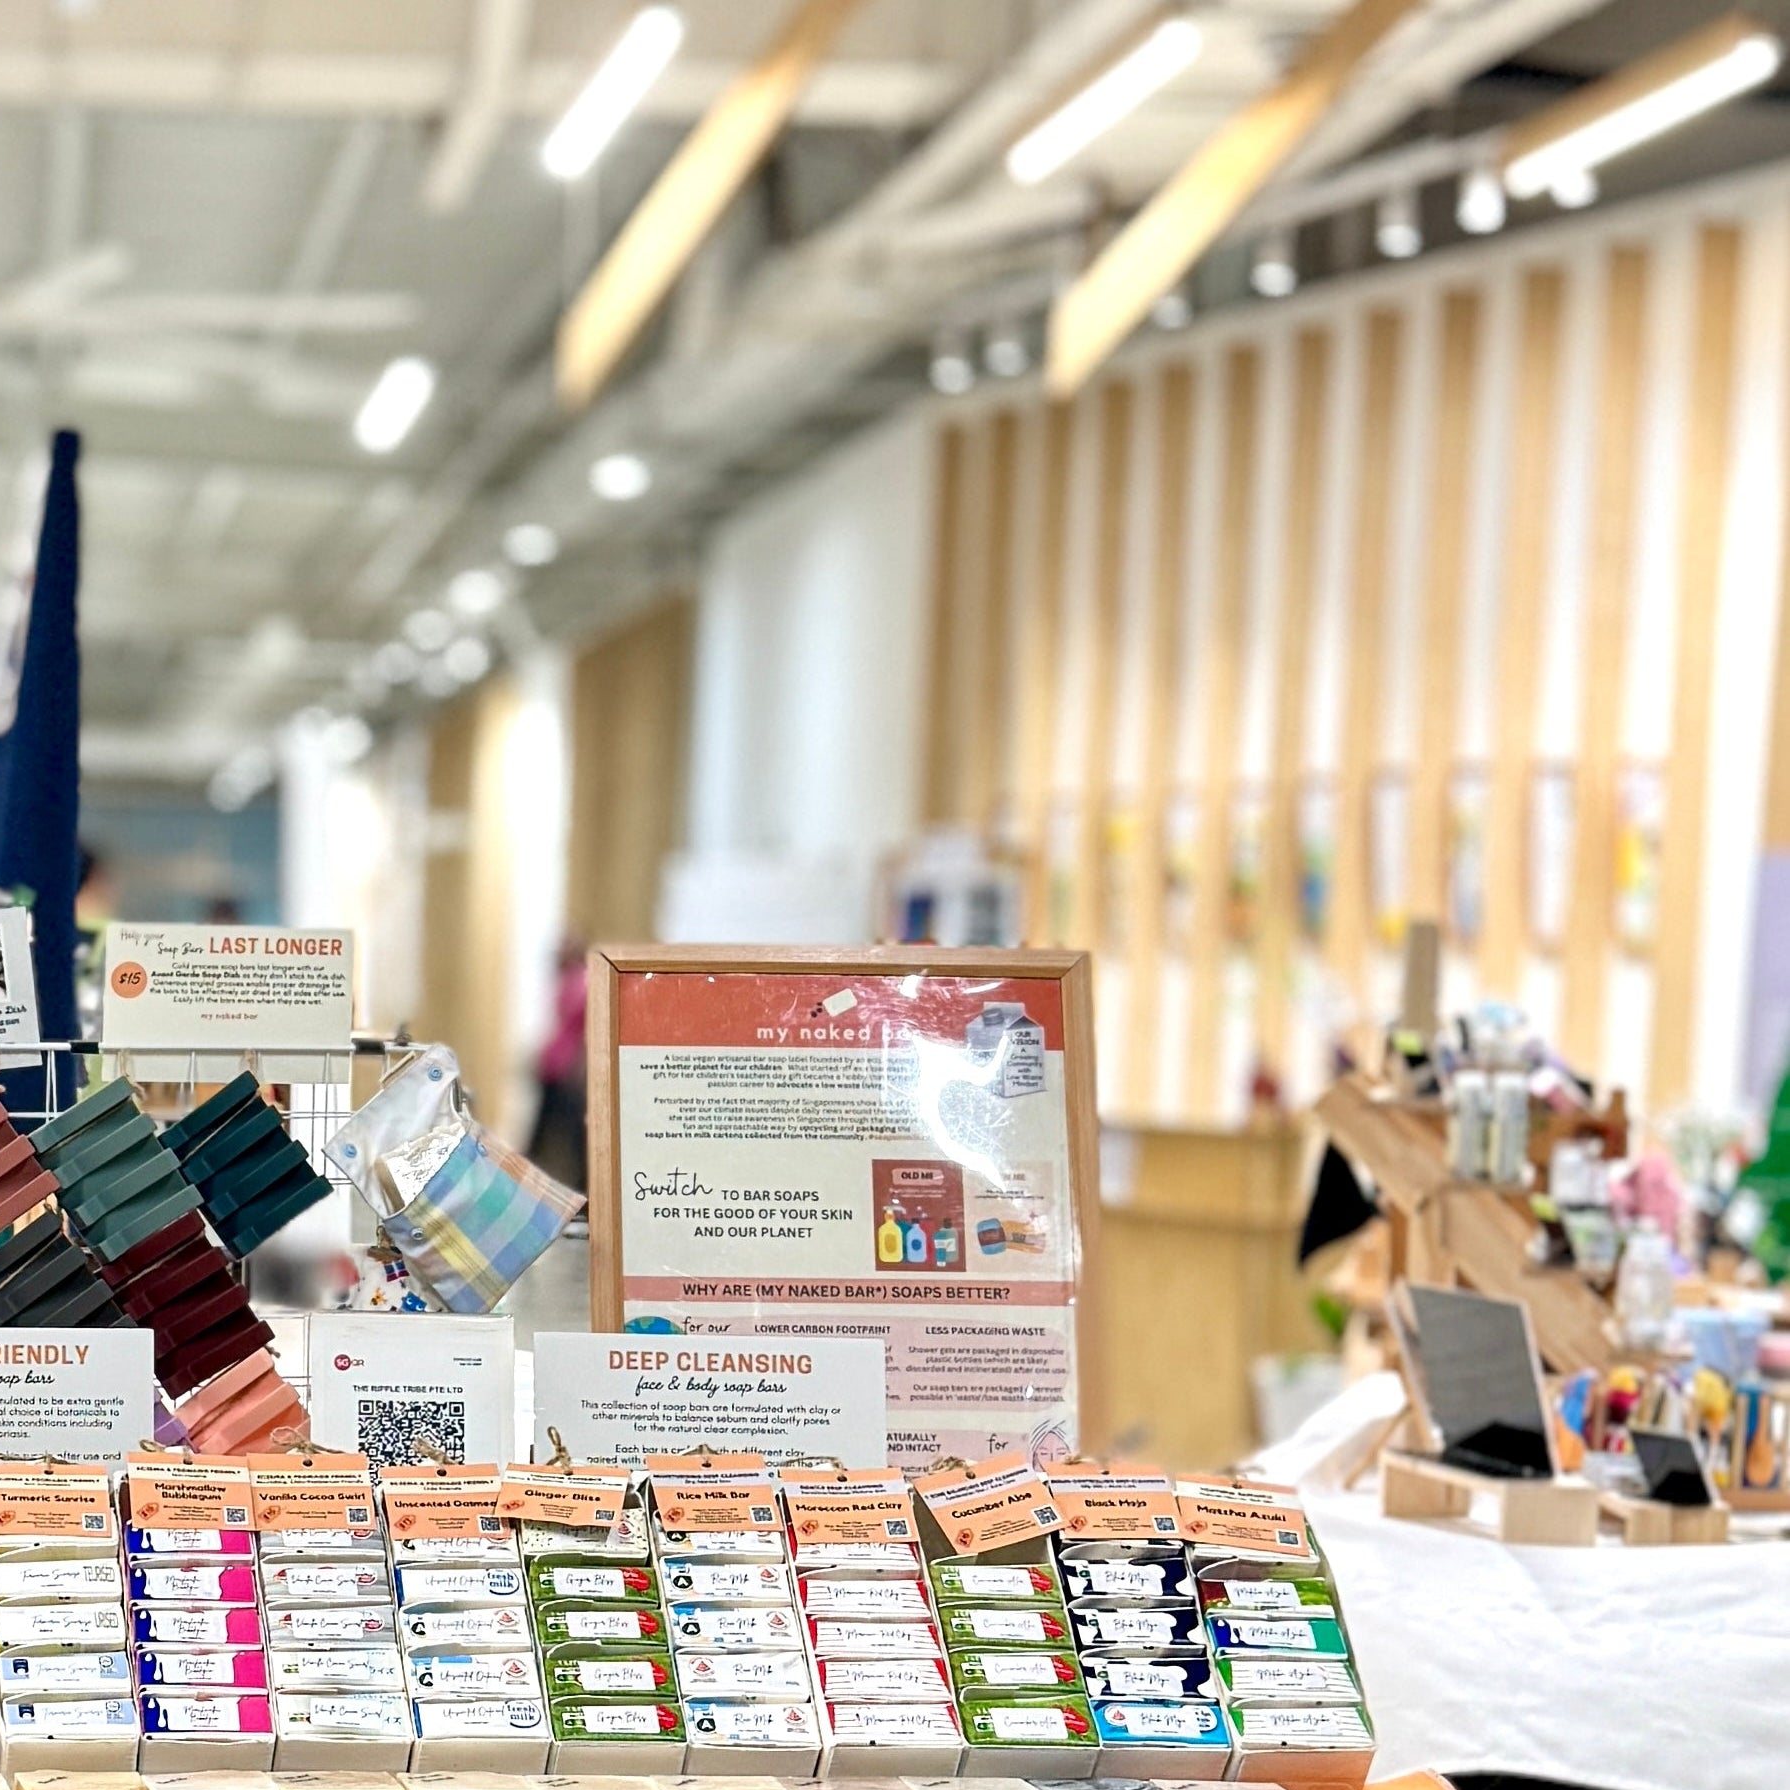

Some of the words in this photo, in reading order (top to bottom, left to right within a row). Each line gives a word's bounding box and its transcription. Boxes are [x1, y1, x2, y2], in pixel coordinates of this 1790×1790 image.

[209, 937, 259, 954] LAST
[264, 937, 342, 956] LONGER
[118, 971, 141, 985] $15
[757, 1027, 791, 1044] my
[800, 1024, 870, 1041] naked
[634, 1166, 713, 1201] Switch
[721, 1189, 740, 1201] TO
[743, 1190, 771, 1201] BAR
[774, 1190, 820, 1202] SOAPS
[654, 1207, 680, 1219] FOR
[683, 1207, 710, 1219] THE
[713, 1208, 755, 1219] GOOD
[758, 1208, 777, 1220] OF
[779, 1208, 818, 1220] YOUR
[821, 1209, 853, 1220] SKIN
[694, 1226, 724, 1238] AND
[727, 1226, 757, 1238] OUR
[761, 1227, 813, 1239] PLANET
[683, 1283, 718, 1296] WHY
[722, 1284, 752, 1297] ARE
[755, 1284, 784, 1297] (MY
[788, 1285, 841, 1298] NAKED
[891, 1286, 942, 1299] SOAPS
[946, 1286, 1011, 1300] BETTER?
[682, 1316, 706, 1334] for
[708, 1322, 732, 1334] our
[753, 1324, 792, 1335] LOWER
[792, 1325, 834, 1335] CARBON
[925, 1326, 949, 1335] LESS
[1011, 1327, 1045, 1337] WASTE
[609, 1350, 669, 1371] DEEP
[676, 1351, 812, 1374] CLEANSING
[24, 1369, 56, 1384] bars
[446, 1386, 464, 1394] LTD
[1, 1493, 51, 1503] Turmeric
[300, 1493, 335, 1501] Cocoa
[524, 1490, 568, 1503] Ginger
[676, 1492, 702, 1500] Rice
[704, 1491, 728, 1500] Milk
[729, 1491, 750, 1499] Bar
[852, 1503, 876, 1511] Red
[877, 1502, 903, 1513] Clay
[1084, 1499, 1117, 1508] Black
[489, 1580, 515, 1589] milk
